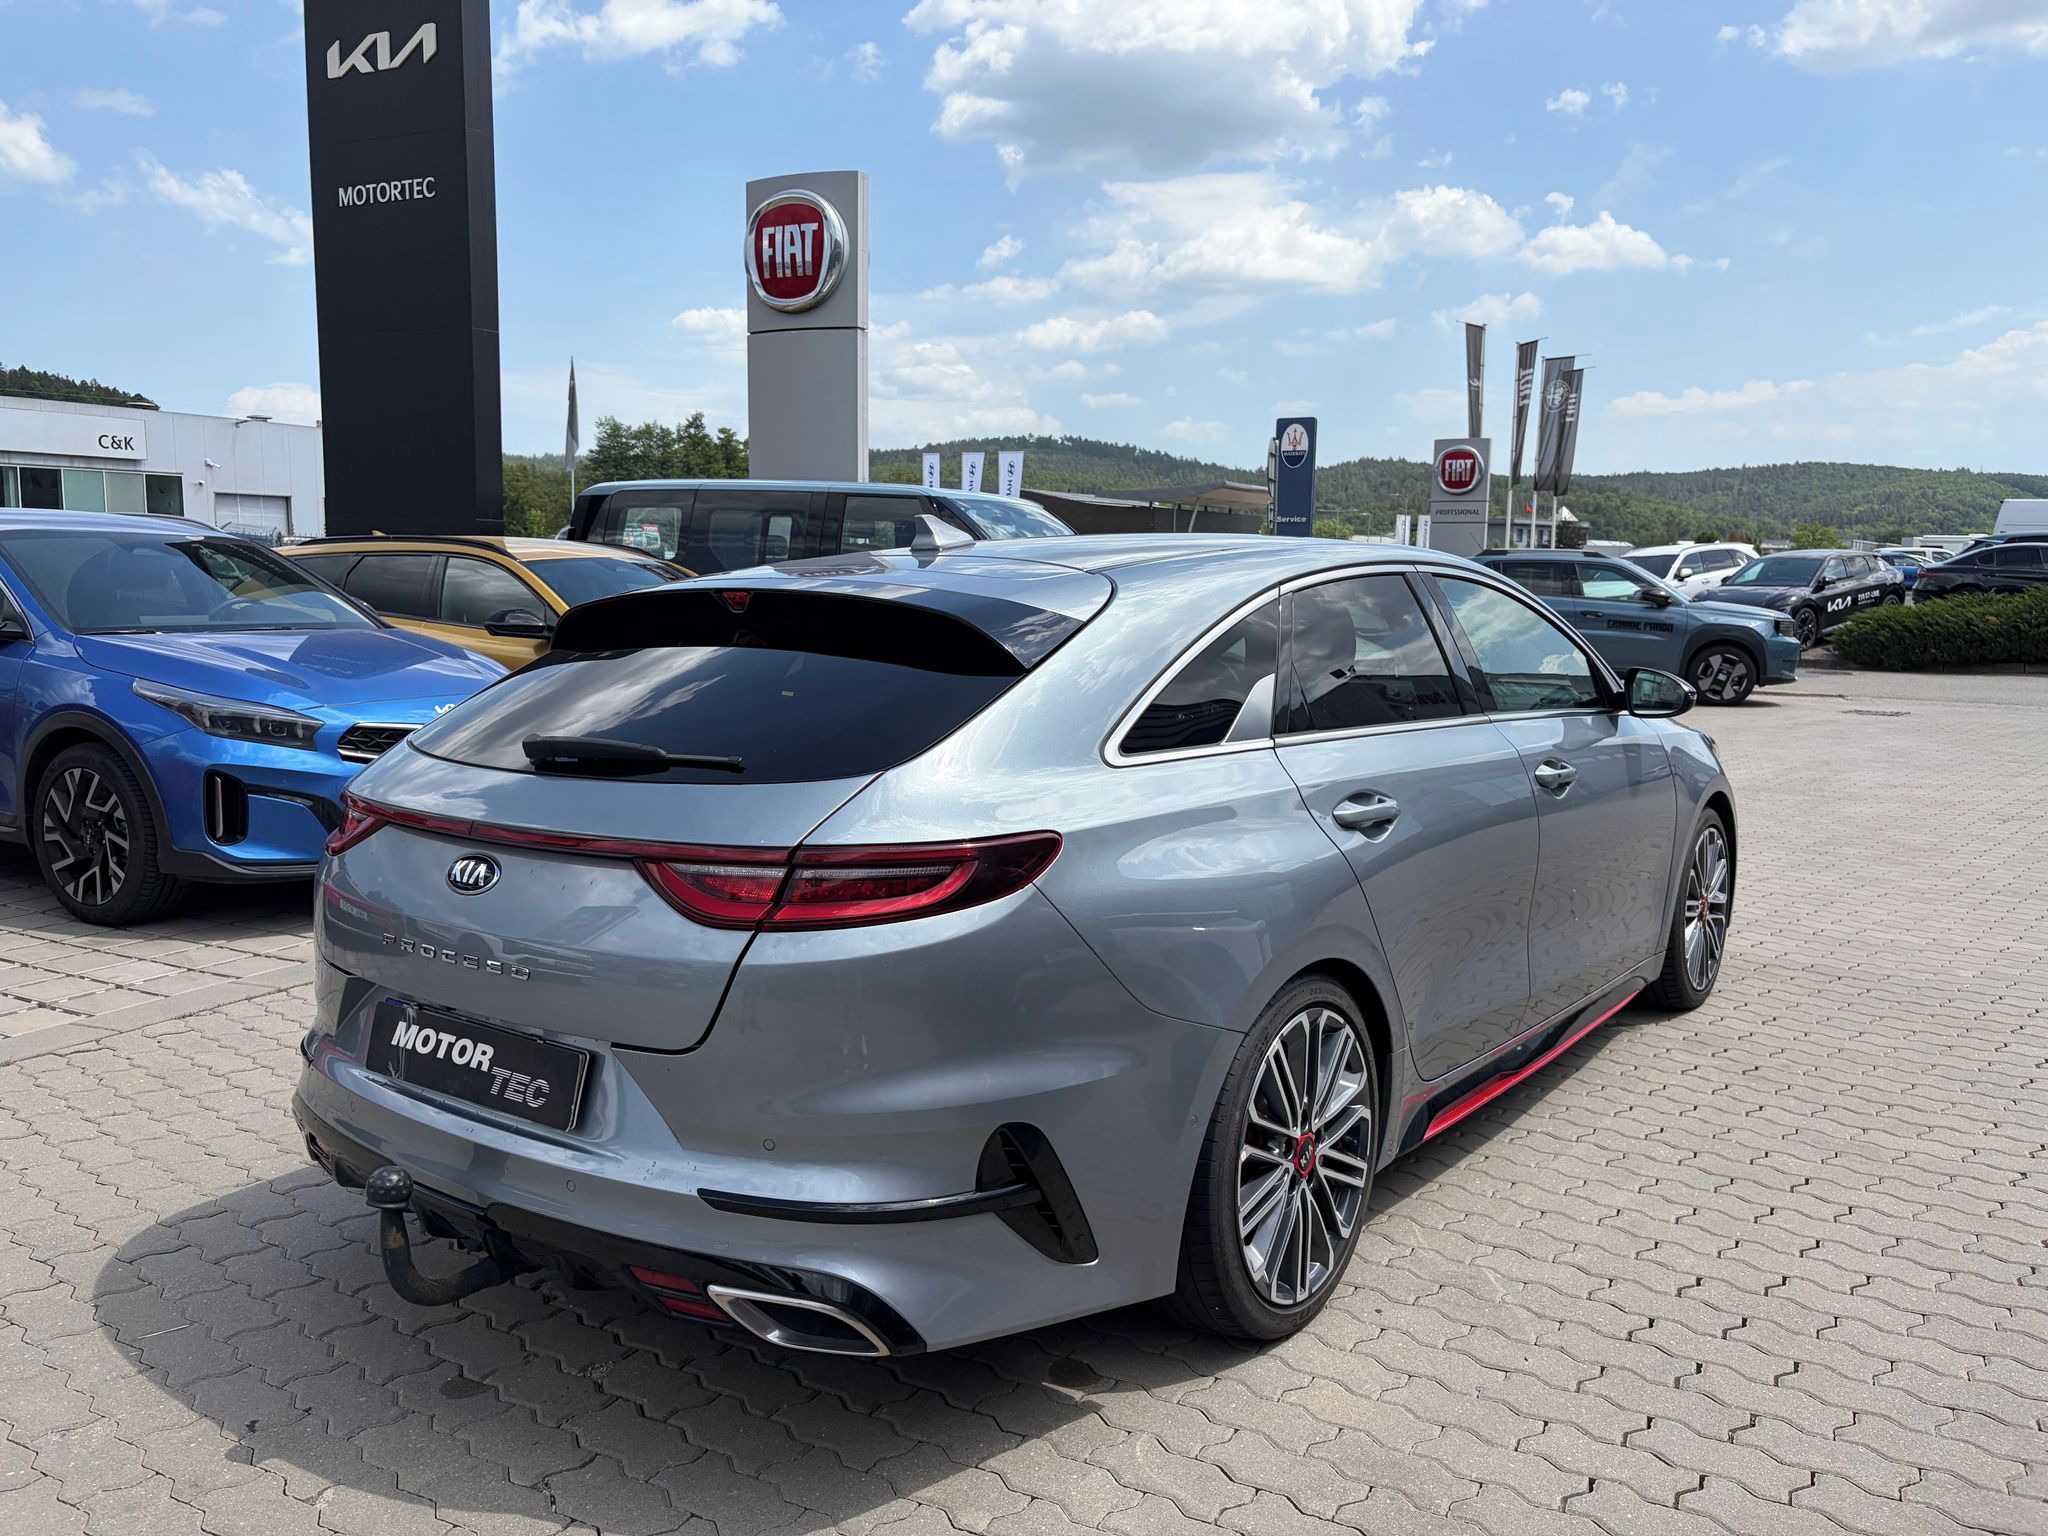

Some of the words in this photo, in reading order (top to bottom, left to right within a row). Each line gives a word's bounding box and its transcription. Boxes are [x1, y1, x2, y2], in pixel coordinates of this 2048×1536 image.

[327, 22, 437, 78] KIA
[338, 177, 436, 207] MOTORTEC
[763, 222, 818, 279] FIAT
[98, 434, 135, 451] C&K
[1444, 459, 1473, 481] FIAT
[1436, 508, 1479, 516] PROFESSIONAL
[1827, 596, 1852, 612] KIA
[451, 860, 487, 886] KIA
[382, 932, 531, 981] PROCEED
[391, 1021, 495, 1072] MOTOR
[490, 1066, 550, 1108] TEC
